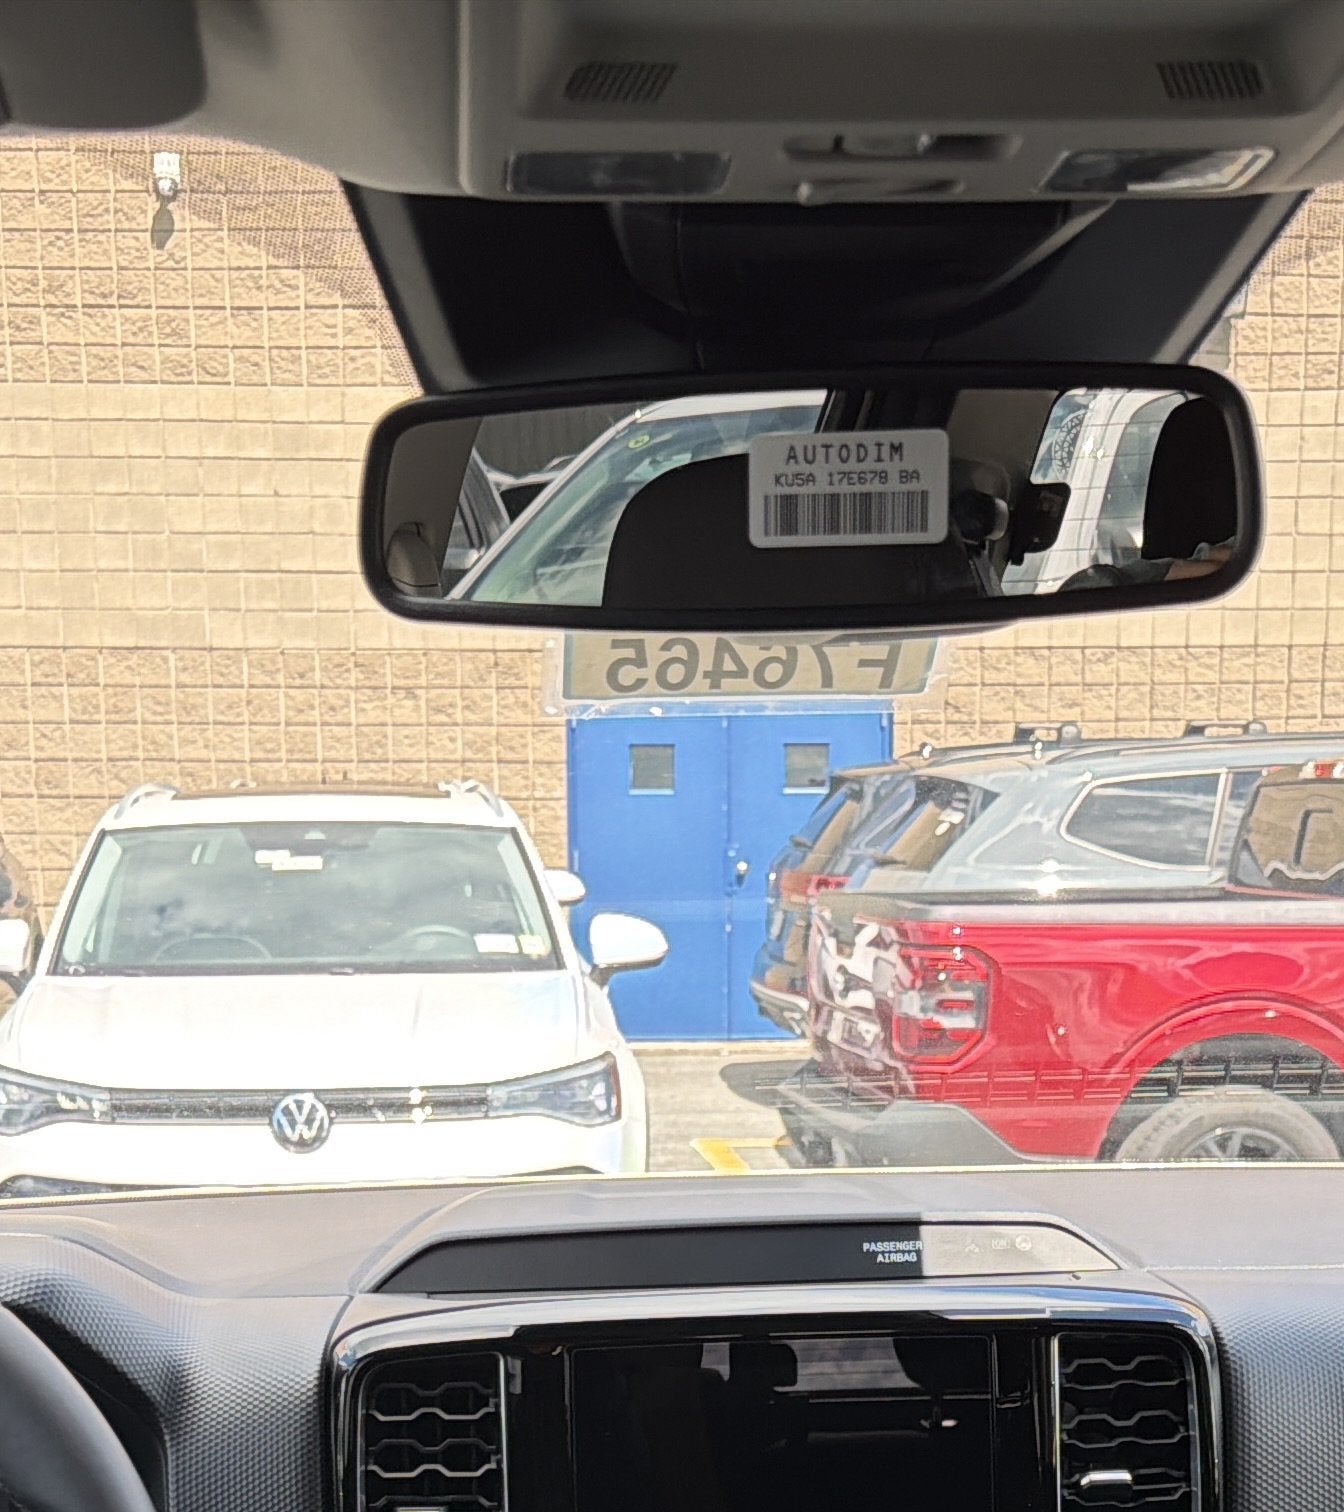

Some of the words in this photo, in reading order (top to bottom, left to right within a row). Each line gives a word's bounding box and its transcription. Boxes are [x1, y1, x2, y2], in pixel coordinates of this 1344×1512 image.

[785, 441, 905, 466] AUTODIM
[827, 470, 889, 487] 17E678
[898, 469, 921, 485] BA
[862, 1241, 923, 1253] PASSENGER
[876, 1252, 918, 1264] AIRBAG
